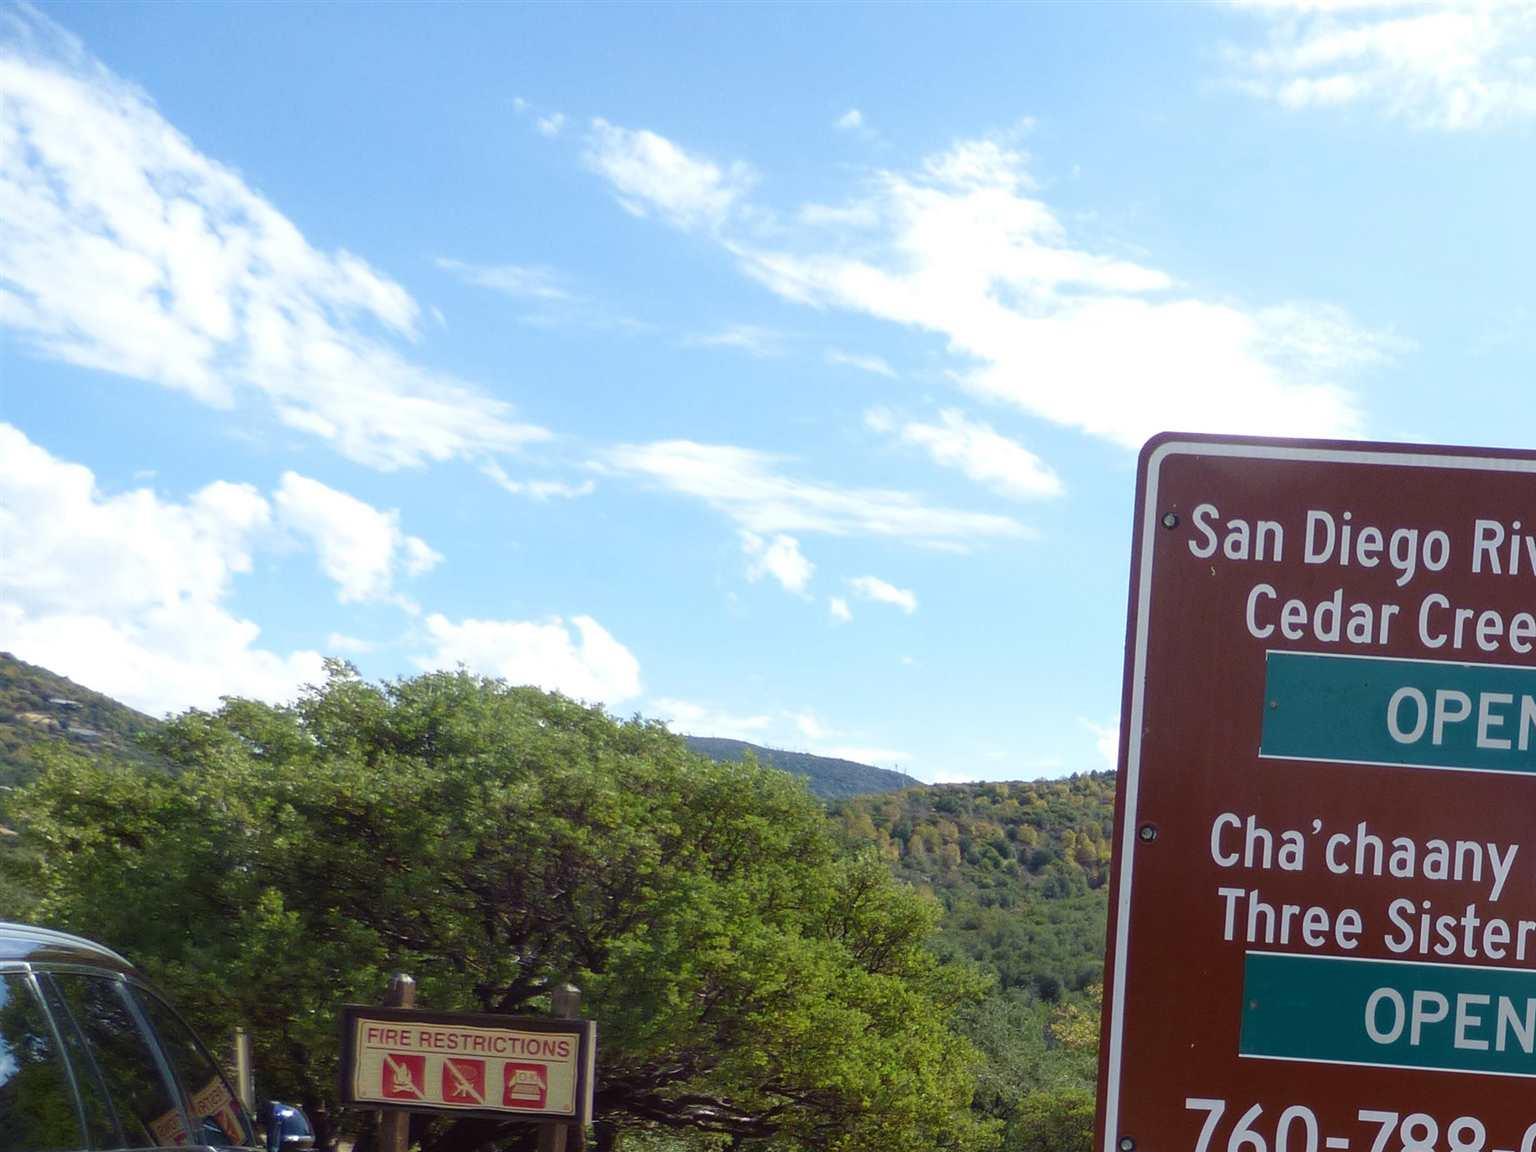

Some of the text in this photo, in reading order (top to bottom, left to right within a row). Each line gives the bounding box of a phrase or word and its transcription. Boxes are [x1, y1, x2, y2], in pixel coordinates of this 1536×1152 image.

[1188, 503, 1284, 562] San
[1304, 510, 1450, 587] Diego
[1246, 583, 1400, 645] Cedar
[1218, 887, 1362, 949] Three
[367, 1028, 570, 1057] FIRE RESTRICTIONS
[1365, 988, 1536, 1053] OPEN
